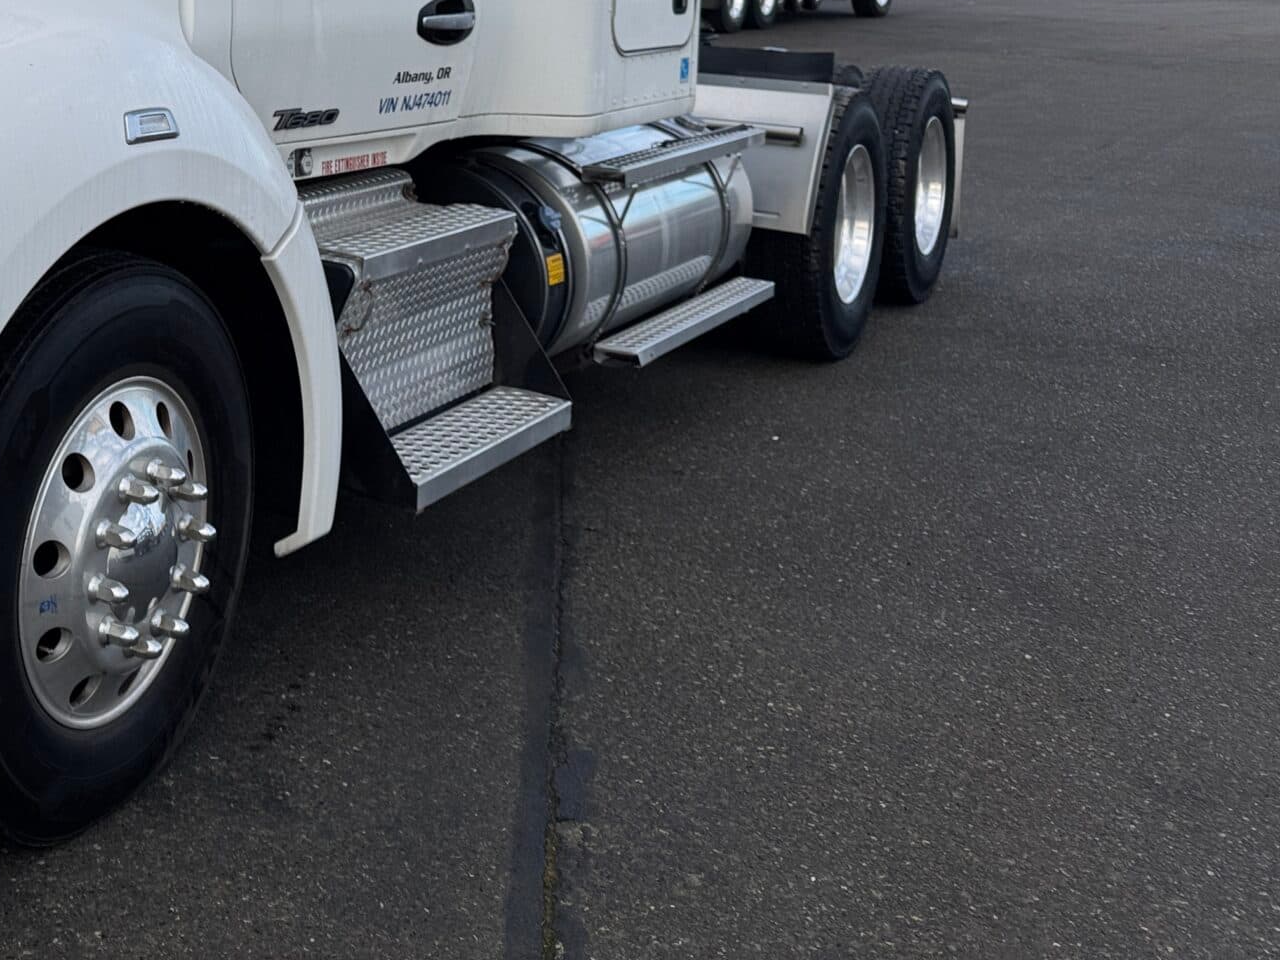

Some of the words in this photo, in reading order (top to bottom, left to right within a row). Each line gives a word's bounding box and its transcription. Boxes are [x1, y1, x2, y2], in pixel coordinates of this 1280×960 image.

[392, 71, 434, 85] Albany,
[436, 66, 452, 80] OR
[379, 96, 400, 115] VIN
[401, 89, 452, 112] NJ474011
[273, 107, 339, 132] T680
[321, 160, 334, 177] FIRE
[334, 153, 371, 174] EXTINGUISHER
[370, 151, 389, 167] INSIDE
